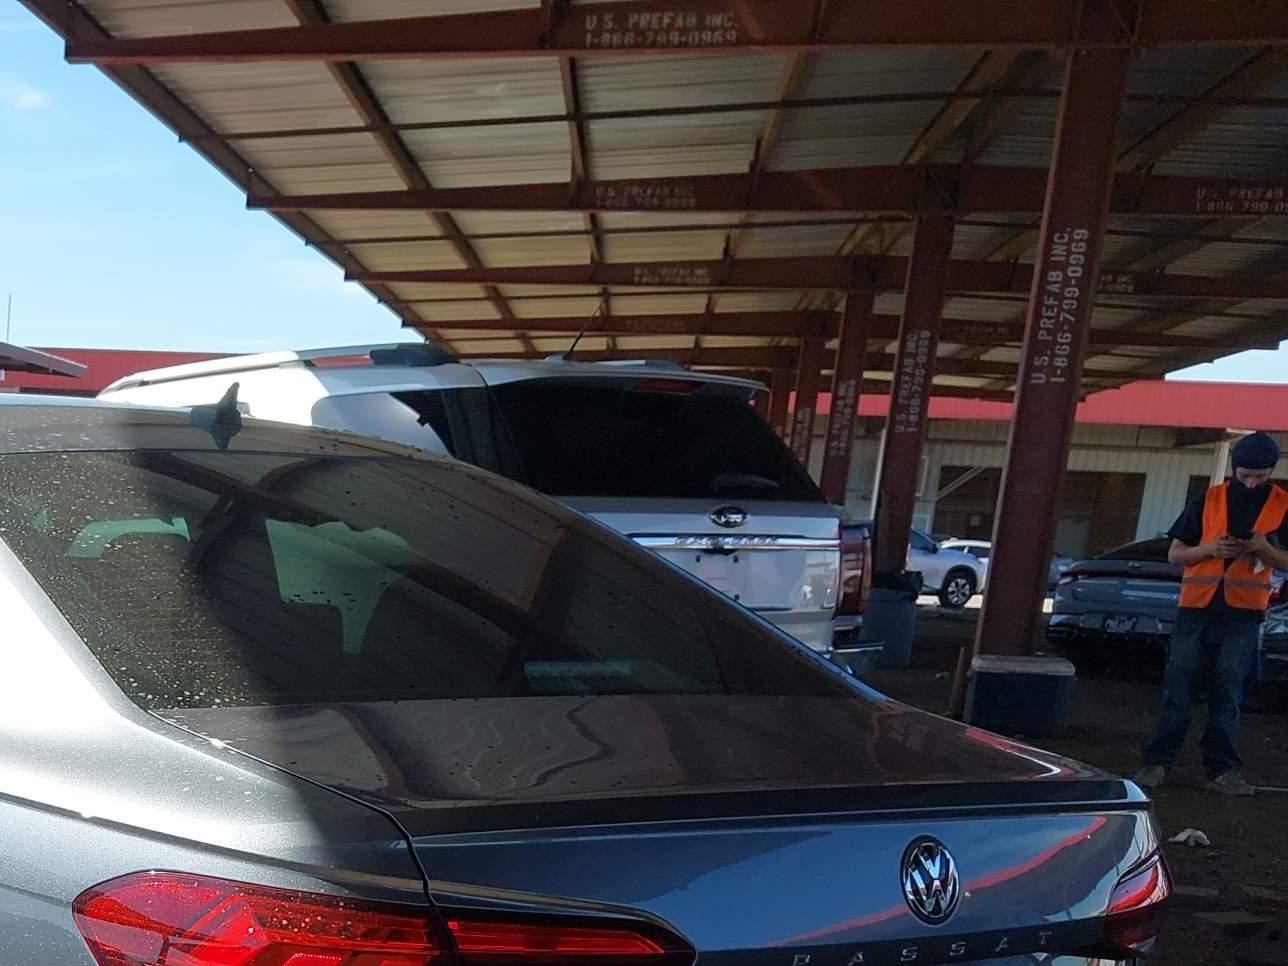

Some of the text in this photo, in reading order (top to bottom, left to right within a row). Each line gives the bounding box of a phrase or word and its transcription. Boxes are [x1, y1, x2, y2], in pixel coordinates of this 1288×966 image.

[627, 11, 697, 30] PREFAB
[1030, 226, 1072, 385] U.S. PREFAB INC.
[1049, 227, 1089, 384] 1-866-799-0969
